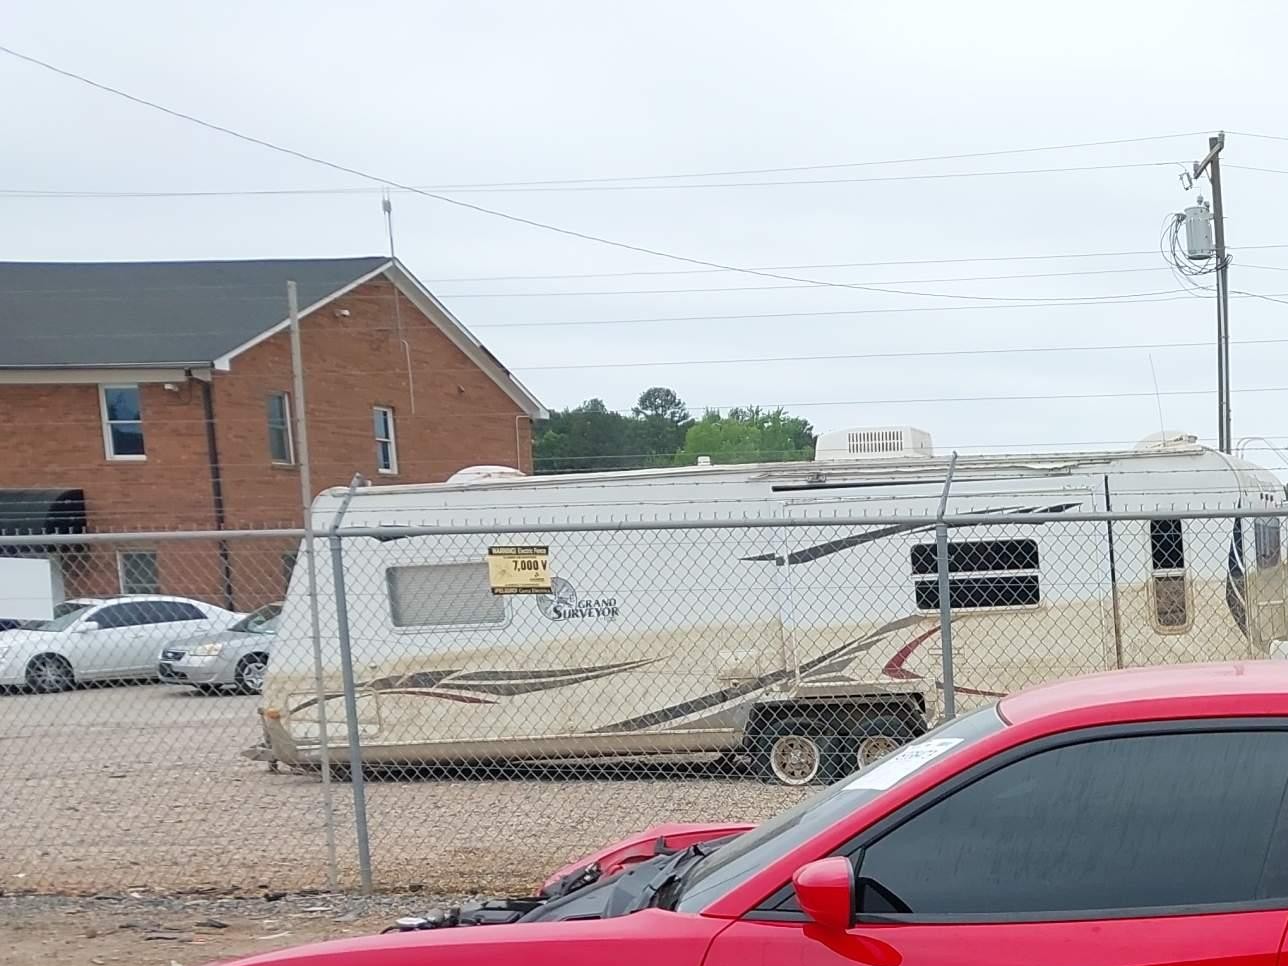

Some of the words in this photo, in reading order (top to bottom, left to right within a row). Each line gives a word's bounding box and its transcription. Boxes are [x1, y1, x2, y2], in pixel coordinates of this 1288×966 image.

[512, 560, 539, 571] 7,000
[541, 560, 547, 571] V
[577, 598, 617, 608] GRAND
[552, 605, 619, 619] SURVEYOR
